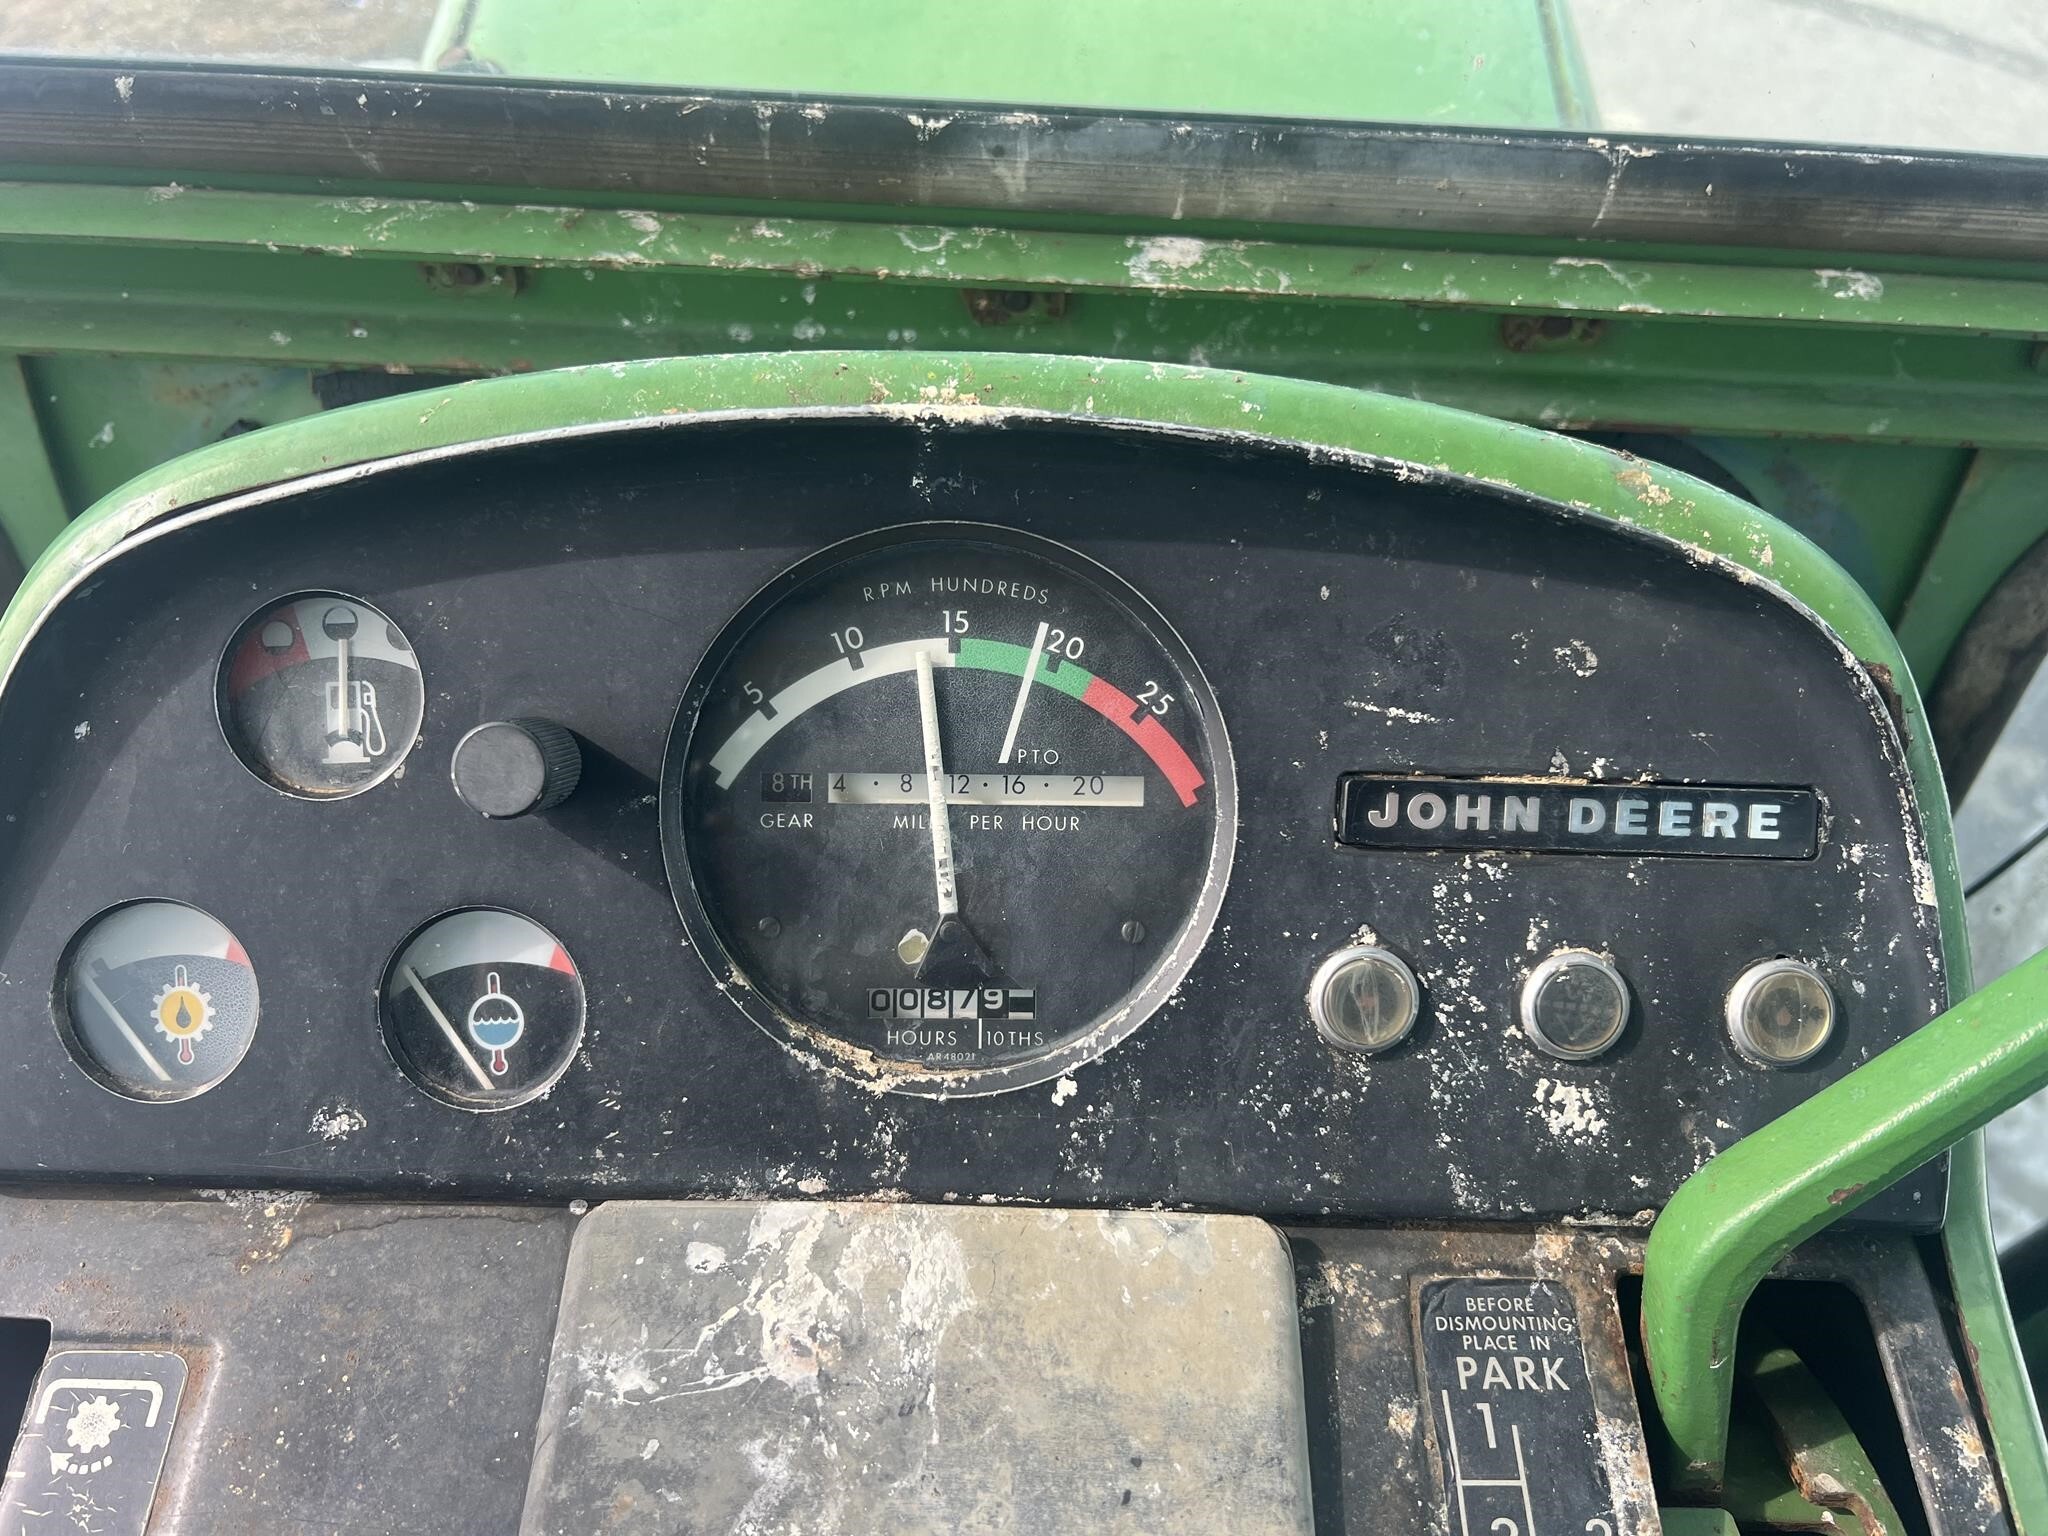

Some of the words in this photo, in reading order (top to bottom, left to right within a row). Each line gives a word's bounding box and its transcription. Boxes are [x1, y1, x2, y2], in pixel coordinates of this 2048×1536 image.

[931, 577, 1049, 605] HUNDREDS
[942, 610, 969, 634] 15
[830, 626, 864, 654] 10
[1046, 629, 1085, 660] 20
[743, 681, 763, 705] 5
[1136, 680, 1175, 715] 25
[832, 774, 846, 793] 4
[900, 774, 912, 793] 8
[949, 774, 970, 794] 12
[1002, 775, 1025, 795] 16
[1073, 776, 1104, 796] 20
[760, 813, 814, 829] GEAR
[970, 815, 1003, 830] PER
[1022, 815, 1080, 831] HOUR
[1367, 791, 1541, 833] JOHN
[1568, 797, 1781, 840] DEERE
[887, 1030, 957, 1046] HOURS
[1465, 1297, 1535, 1312] BEFORE
[1435, 1316, 1573, 1332] DISMOUNTING
[1462, 1335, 1518, 1350] PLACE
[1530, 1335, 1550, 1350] IN
[1455, 1356, 1571, 1391] PARK
[1476, 1402, 1497, 1449] 1
